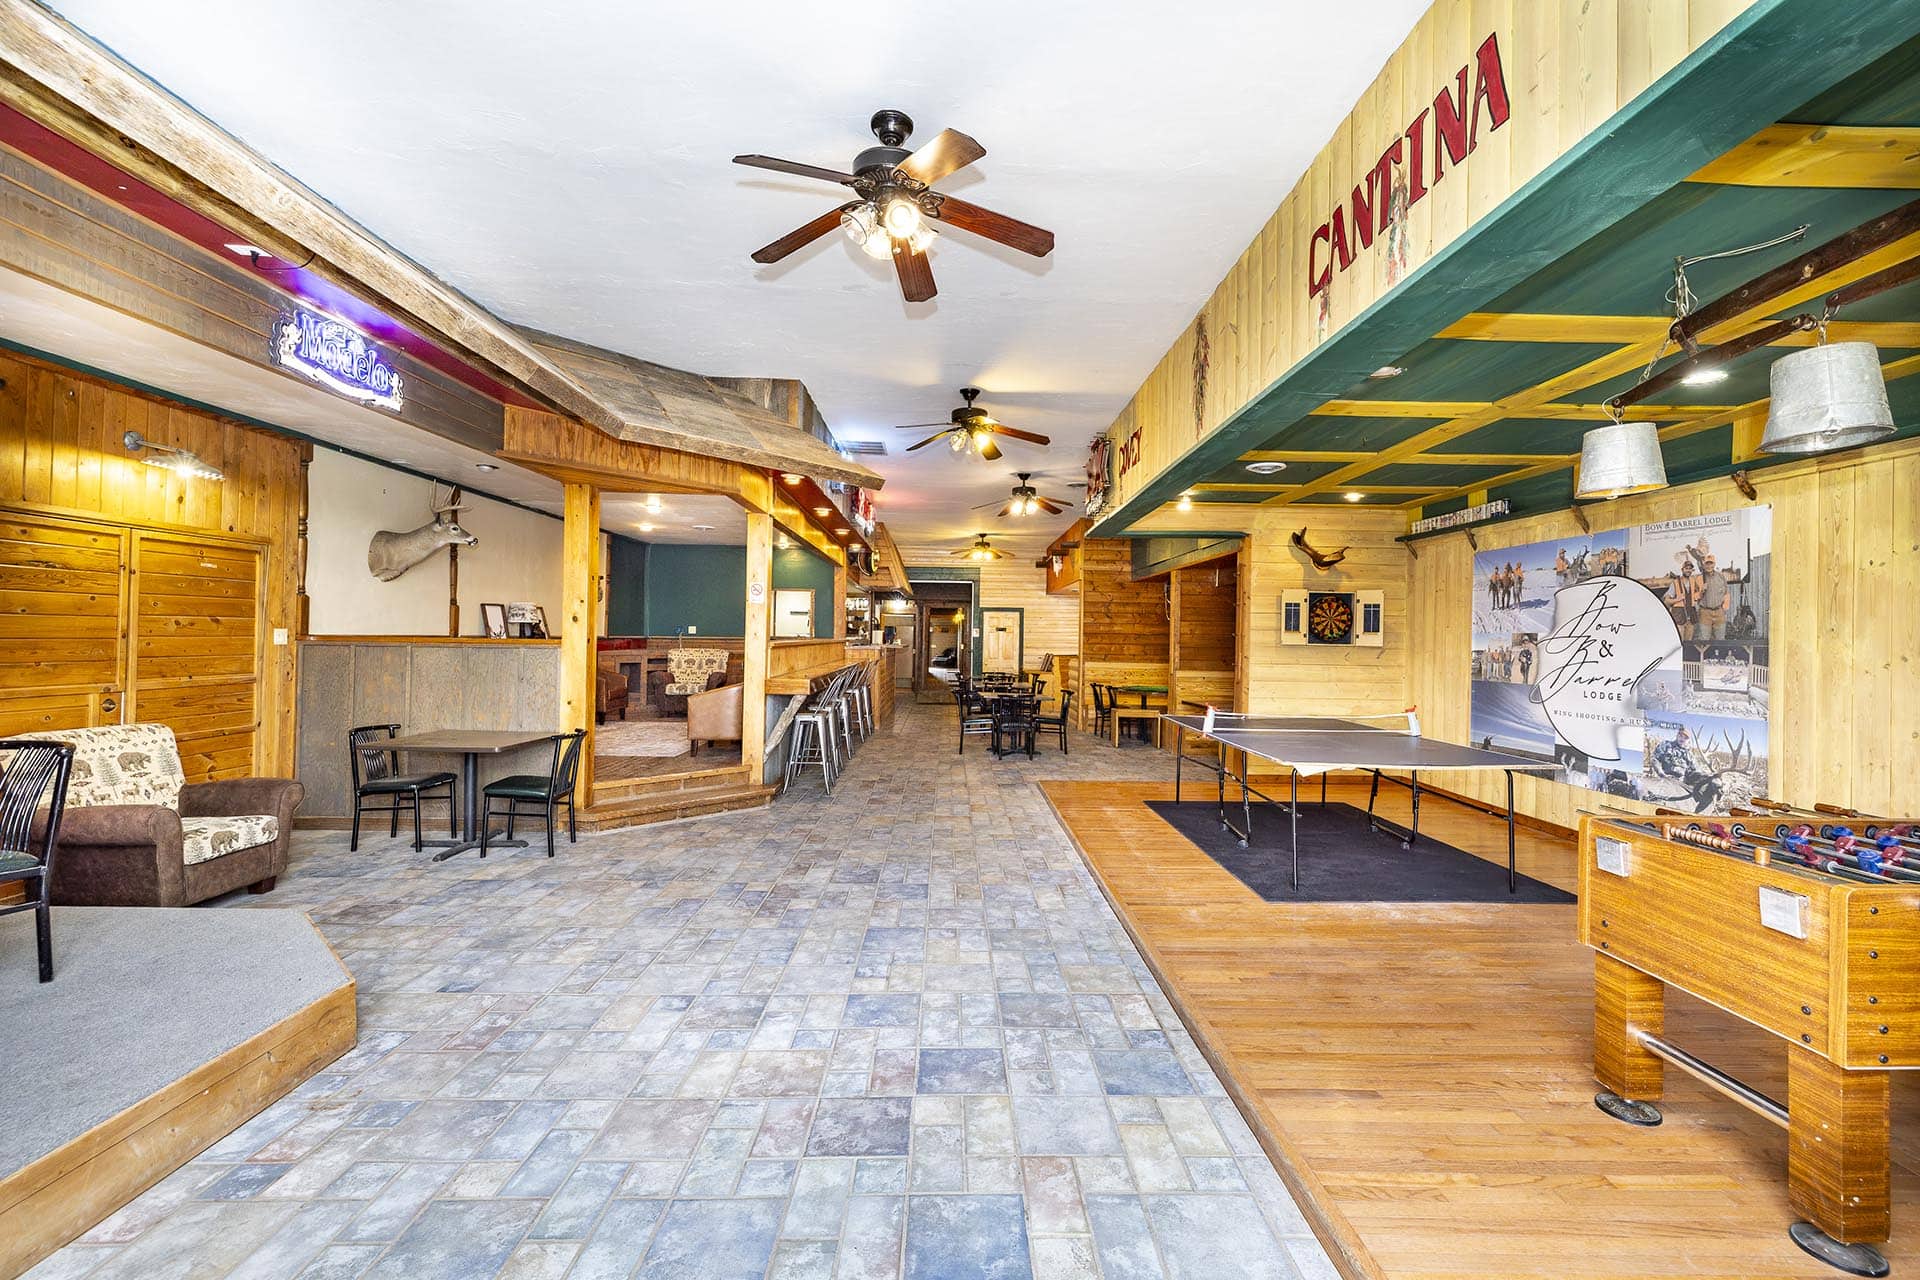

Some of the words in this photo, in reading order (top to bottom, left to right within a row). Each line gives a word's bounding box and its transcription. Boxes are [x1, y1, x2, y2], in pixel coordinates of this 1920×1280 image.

[1309, 31, 1511, 300] CANTINA
[301, 312, 390, 392] Modelo
[1645, 523, 1663, 531] BOW
[1672, 518, 1703, 529] BARREL
[1704, 515, 1732, 526] LODGE
[1545, 580, 1636, 654] Bow
[1598, 640, 1615, 658] &
[1583, 690, 1623, 701] LODGE
[1575, 711, 1617, 723] SHOOTING
